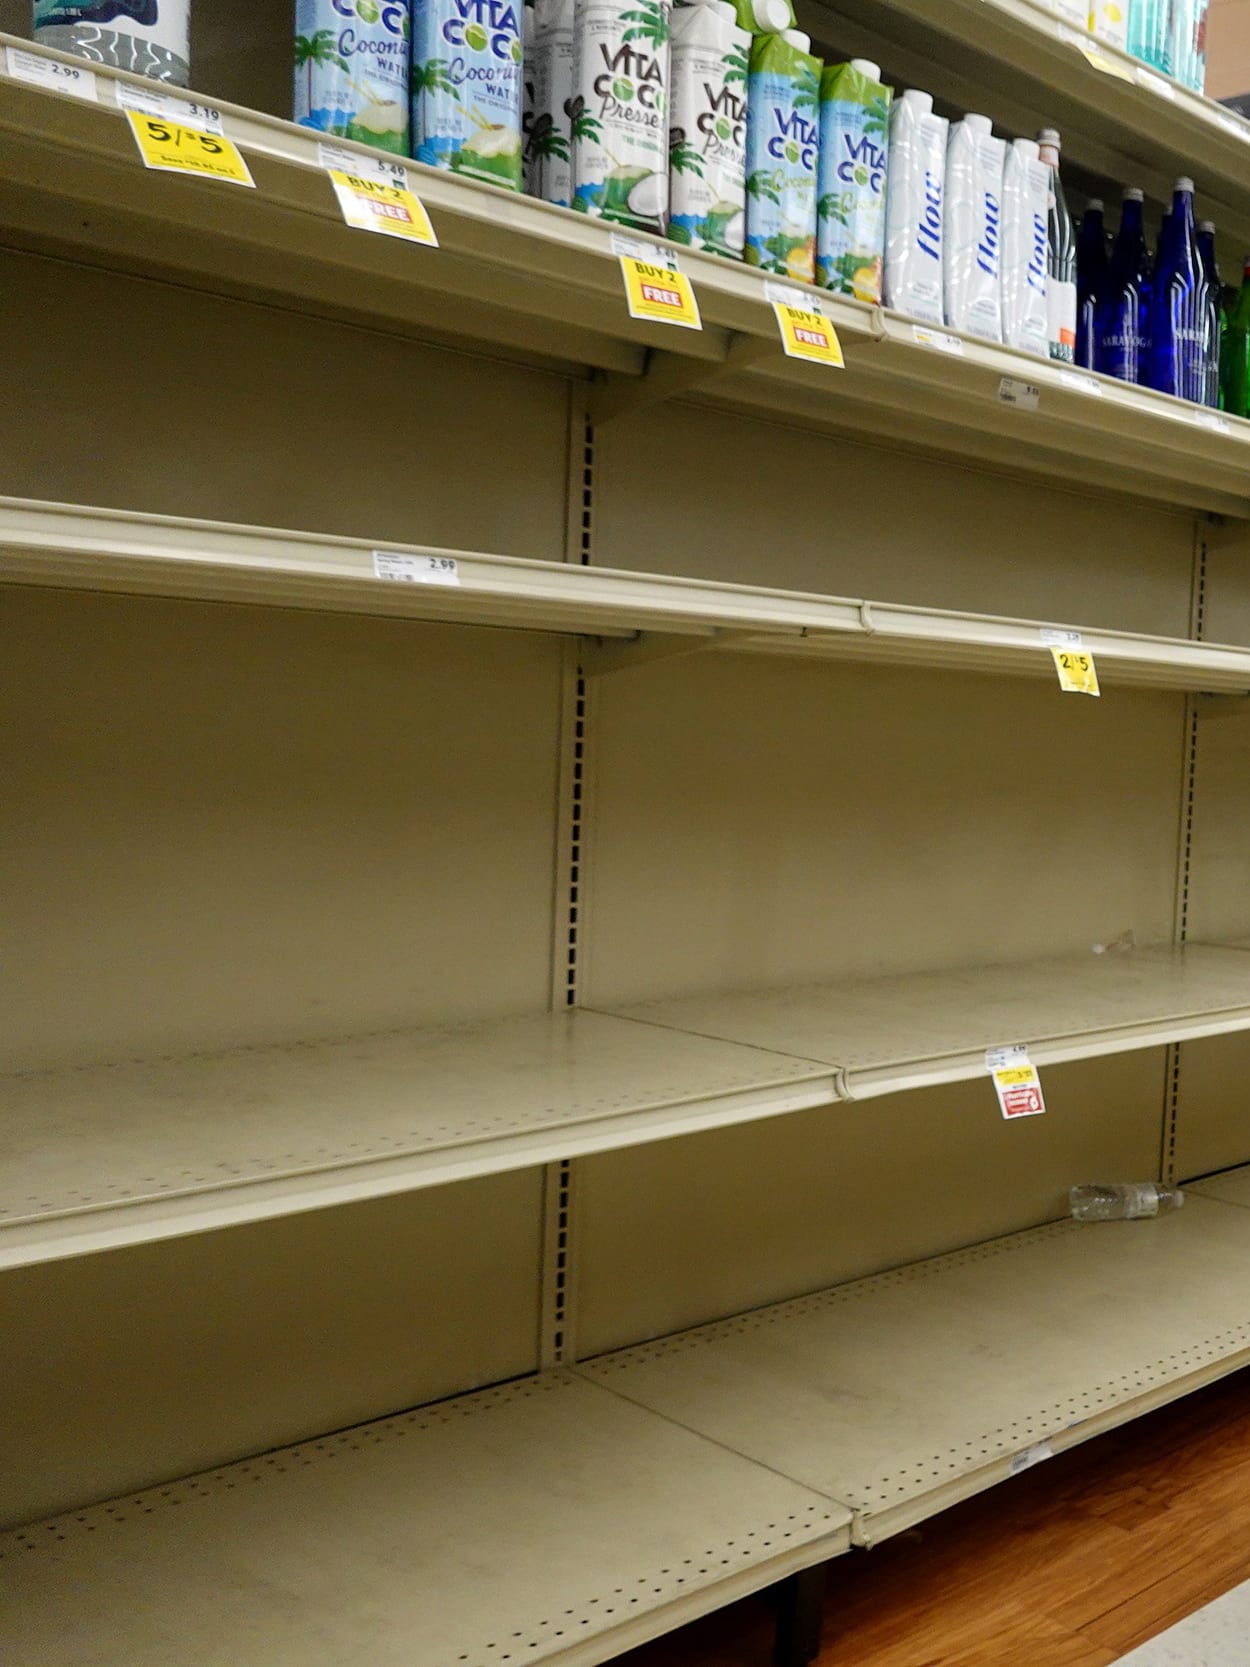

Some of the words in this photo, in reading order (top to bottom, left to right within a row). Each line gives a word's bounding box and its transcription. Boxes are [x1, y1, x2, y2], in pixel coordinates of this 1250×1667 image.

[332, 0, 410, 39] COC
[454, 0, 519, 38] VITA
[52, 63, 80, 80] 2.99
[599, 43, 664, 87] VITA
[190, 103, 220, 121] 3.19
[599, 95, 661, 129] Presse
[697, 112, 746, 147] COC
[768, 135, 817, 171] COC
[844, 133, 886, 170] VITA
[347, 175, 386, 195] BUY
[837, 161, 886, 194] COC
[368, 199, 412, 223] FREE
[976, 191, 1001, 281] flow
[1027, 213, 1048, 298] flow
[634, 262, 664, 280] BUY
[667, 272, 677, 284] 2
[643, 285, 683, 307] FREE
[787, 307, 811, 323] BUY
[813, 315, 823, 327] 2
[795, 327, 829, 347] FREE
